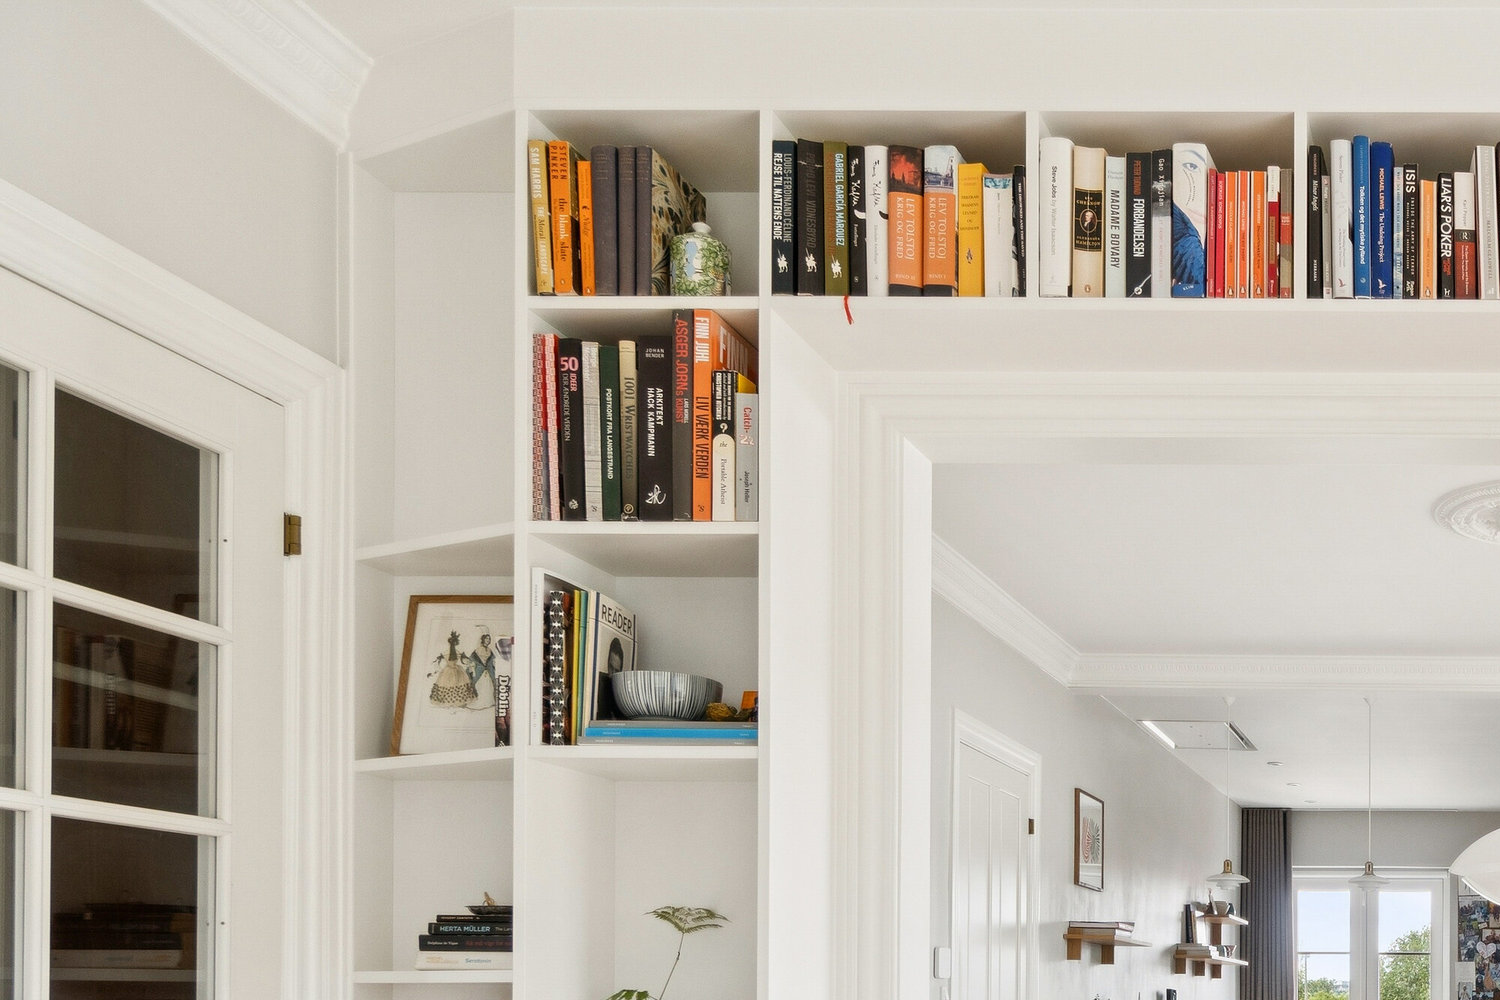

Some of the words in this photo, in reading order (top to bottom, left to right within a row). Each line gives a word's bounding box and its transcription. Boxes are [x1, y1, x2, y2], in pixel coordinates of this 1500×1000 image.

[530, 147, 540, 164] SAM
[551, 146, 559, 180] PINKER
[773, 153, 783, 175] REJSE
[835, 153, 844, 183] GABRIEL
[532, 168, 542, 198] HARRIS
[774, 176, 783, 187] TIL
[783, 153, 792, 217] LOUIS-FERDINAND
[1405, 169, 1415, 193] ISIS
[558, 198, 567, 212] the
[773, 189, 782, 220] NATTENS
[835, 184, 846, 211] GARCÍA
[896, 197, 904, 218] KRIG
[906, 198, 915, 214] LEV
[928, 197, 936, 218] KRIG
[938, 197, 947, 215] LEV
[1440, 177, 1452, 213] LIAR'S
[1110, 190, 1119, 230] MADAME
[559, 214, 568, 239] blank
[774, 221, 783, 240] ENDE
[783, 218, 793, 243] CÉLINE
[835, 212, 846, 246] MÁRQUEZ
[896, 221, 904, 234] OG
[928, 221, 936, 234] OG
[936, 219, 947, 259] TOLSTOJ
[1440, 215, 1452, 258] POKER
[560, 241, 568, 262] slate
[896, 236, 904, 258] FRED
[904, 220, 915, 261] TOLSTOJ
[928, 236, 936, 258] FRED
[1110, 234, 1120, 268] BOVARY
[676, 320, 688, 358] ASGER
[696, 317, 709, 339] FINN
[560, 357, 579, 371] 50
[696, 341, 709, 363] JUHL
[569, 373, 577, 392] IDEER
[624, 377, 634, 400] 1001
[647, 387, 655, 409] HACK
[656, 387, 664, 426] ARKITEKT
[676, 398, 684, 423] KUNST
[696, 396, 709, 411] LIV
[647, 411, 655, 457] KAMPMANN
[696, 413, 709, 440] VÆRK
[624, 405, 635, 480] WRISTWATCHES
[696, 443, 709, 479] VERDEN
[602, 604, 633, 636] READER
